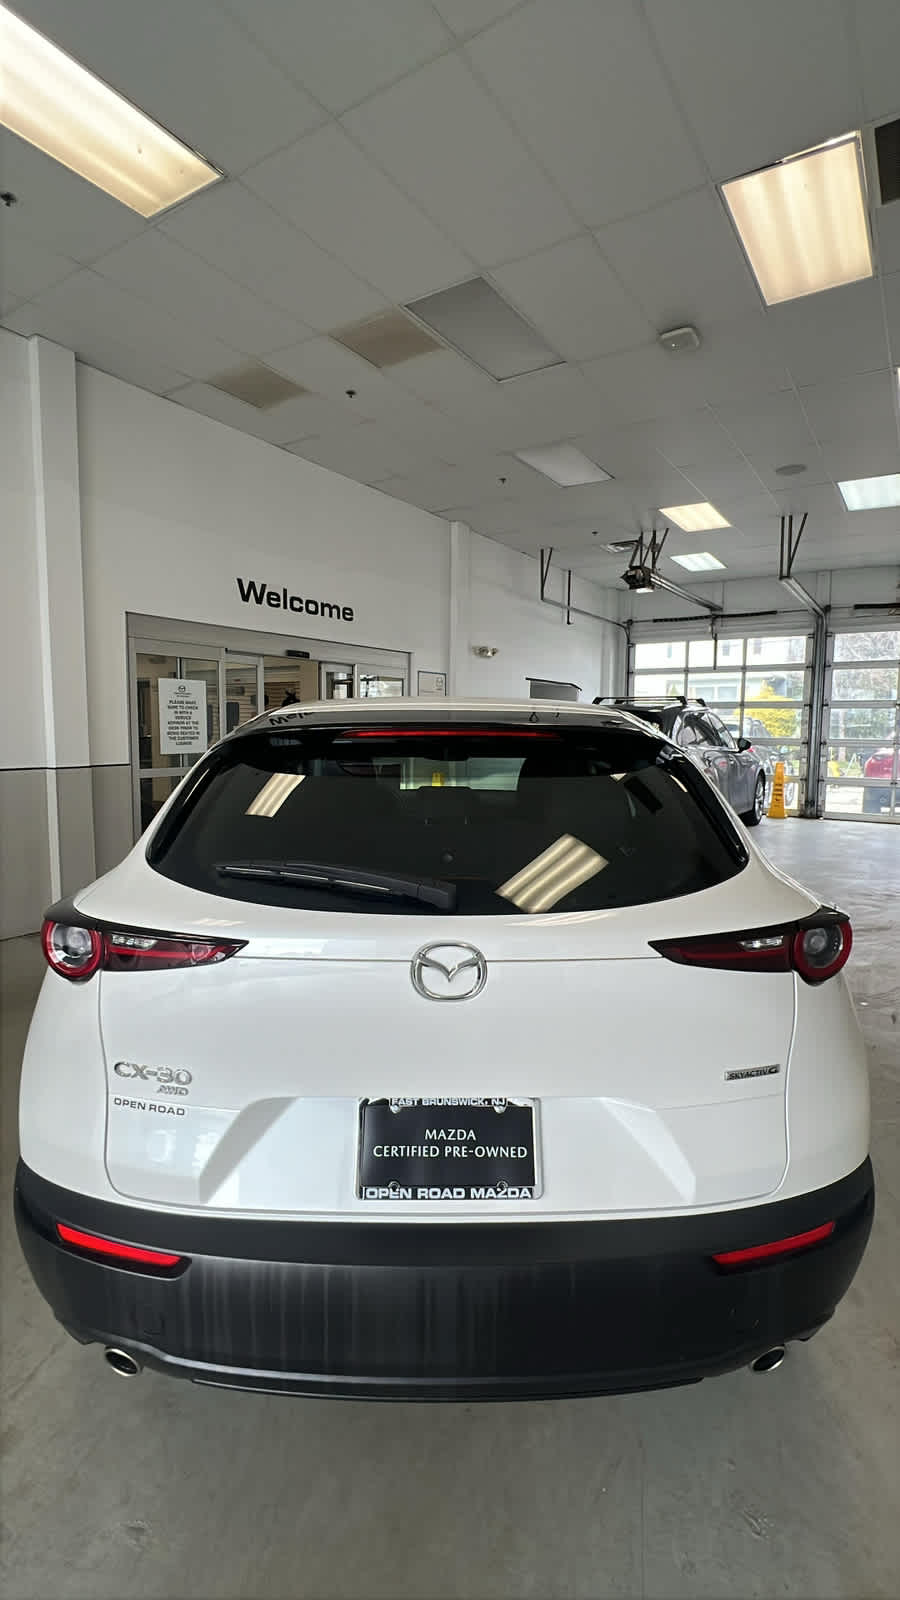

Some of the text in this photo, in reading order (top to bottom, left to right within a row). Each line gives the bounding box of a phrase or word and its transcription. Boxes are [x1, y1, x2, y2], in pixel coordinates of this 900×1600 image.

[236, 577, 354, 622] Welcome
[114, 1062, 192, 1086] CX-30
[156, 1085, 189, 1096] AWD
[114, 1097, 185, 1116] OPEN ROAD
[424, 1129, 476, 1140] MAZDA
[373, 1146, 528, 1158] CERTIFIED PRE-OWNED
[366, 1187, 532, 1199] OPEN ROAD MAZDA
